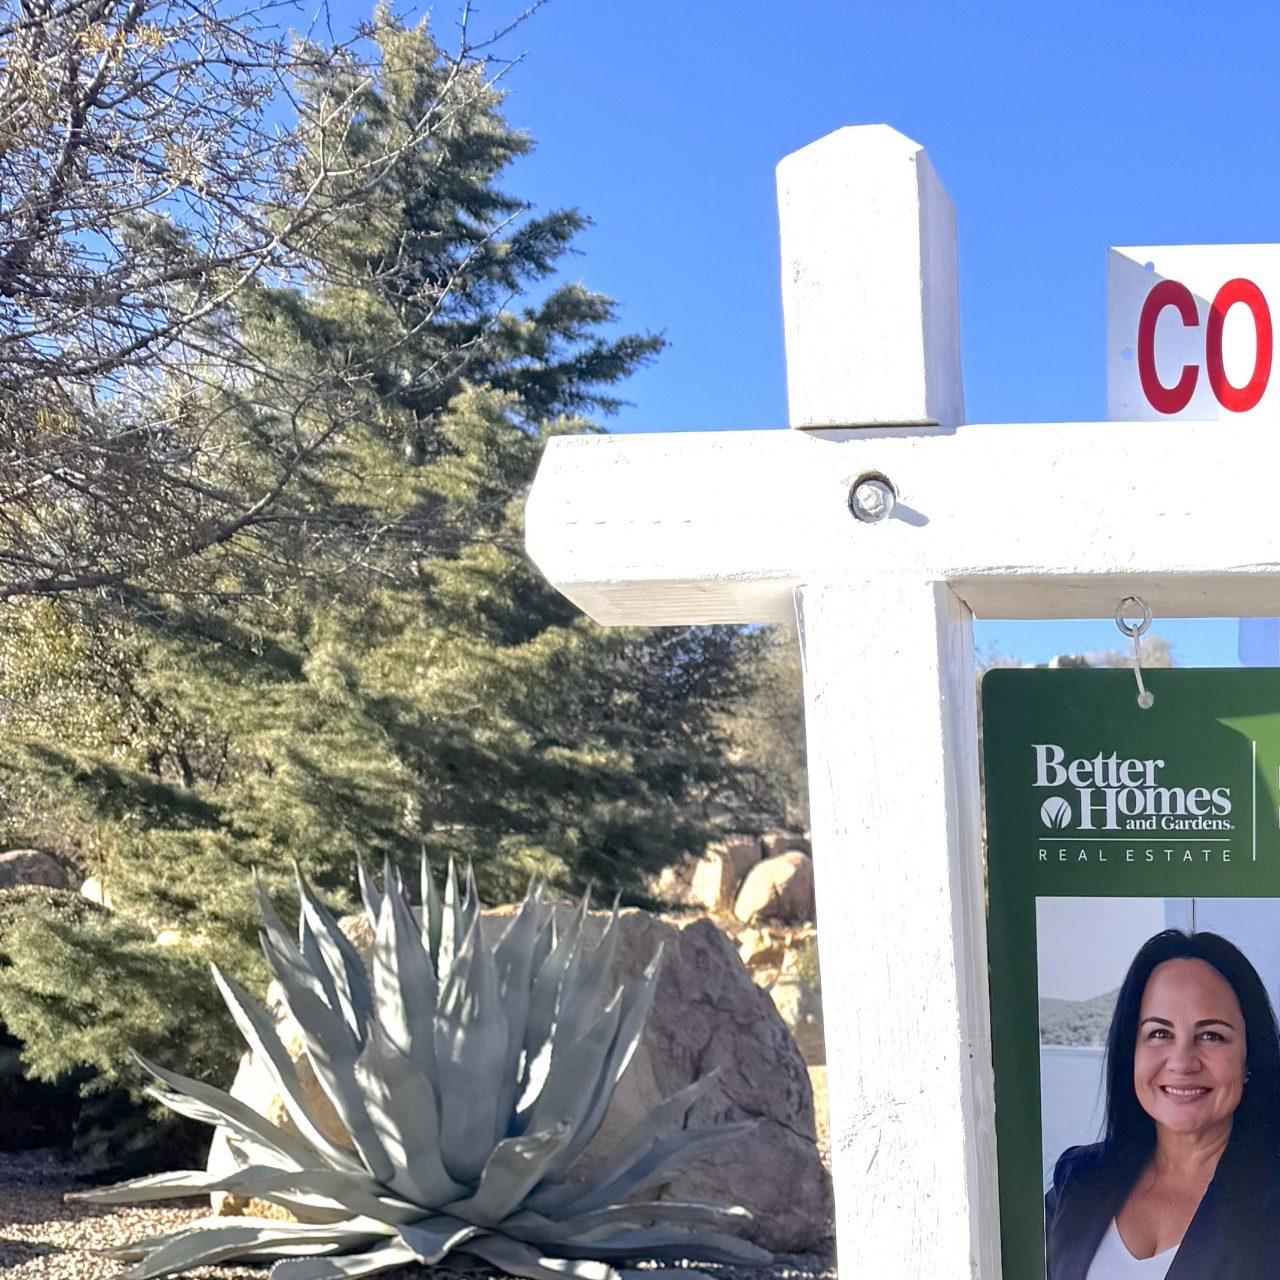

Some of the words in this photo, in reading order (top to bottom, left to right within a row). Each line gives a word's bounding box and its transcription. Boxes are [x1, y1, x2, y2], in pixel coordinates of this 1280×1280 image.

[1031, 744, 1165, 787] Better
[1075, 787, 1232, 830] Homes
[1126, 816, 1157, 830] and
[1039, 849, 1108, 861] REAL
[1126, 849, 1231, 862] ESTATE
